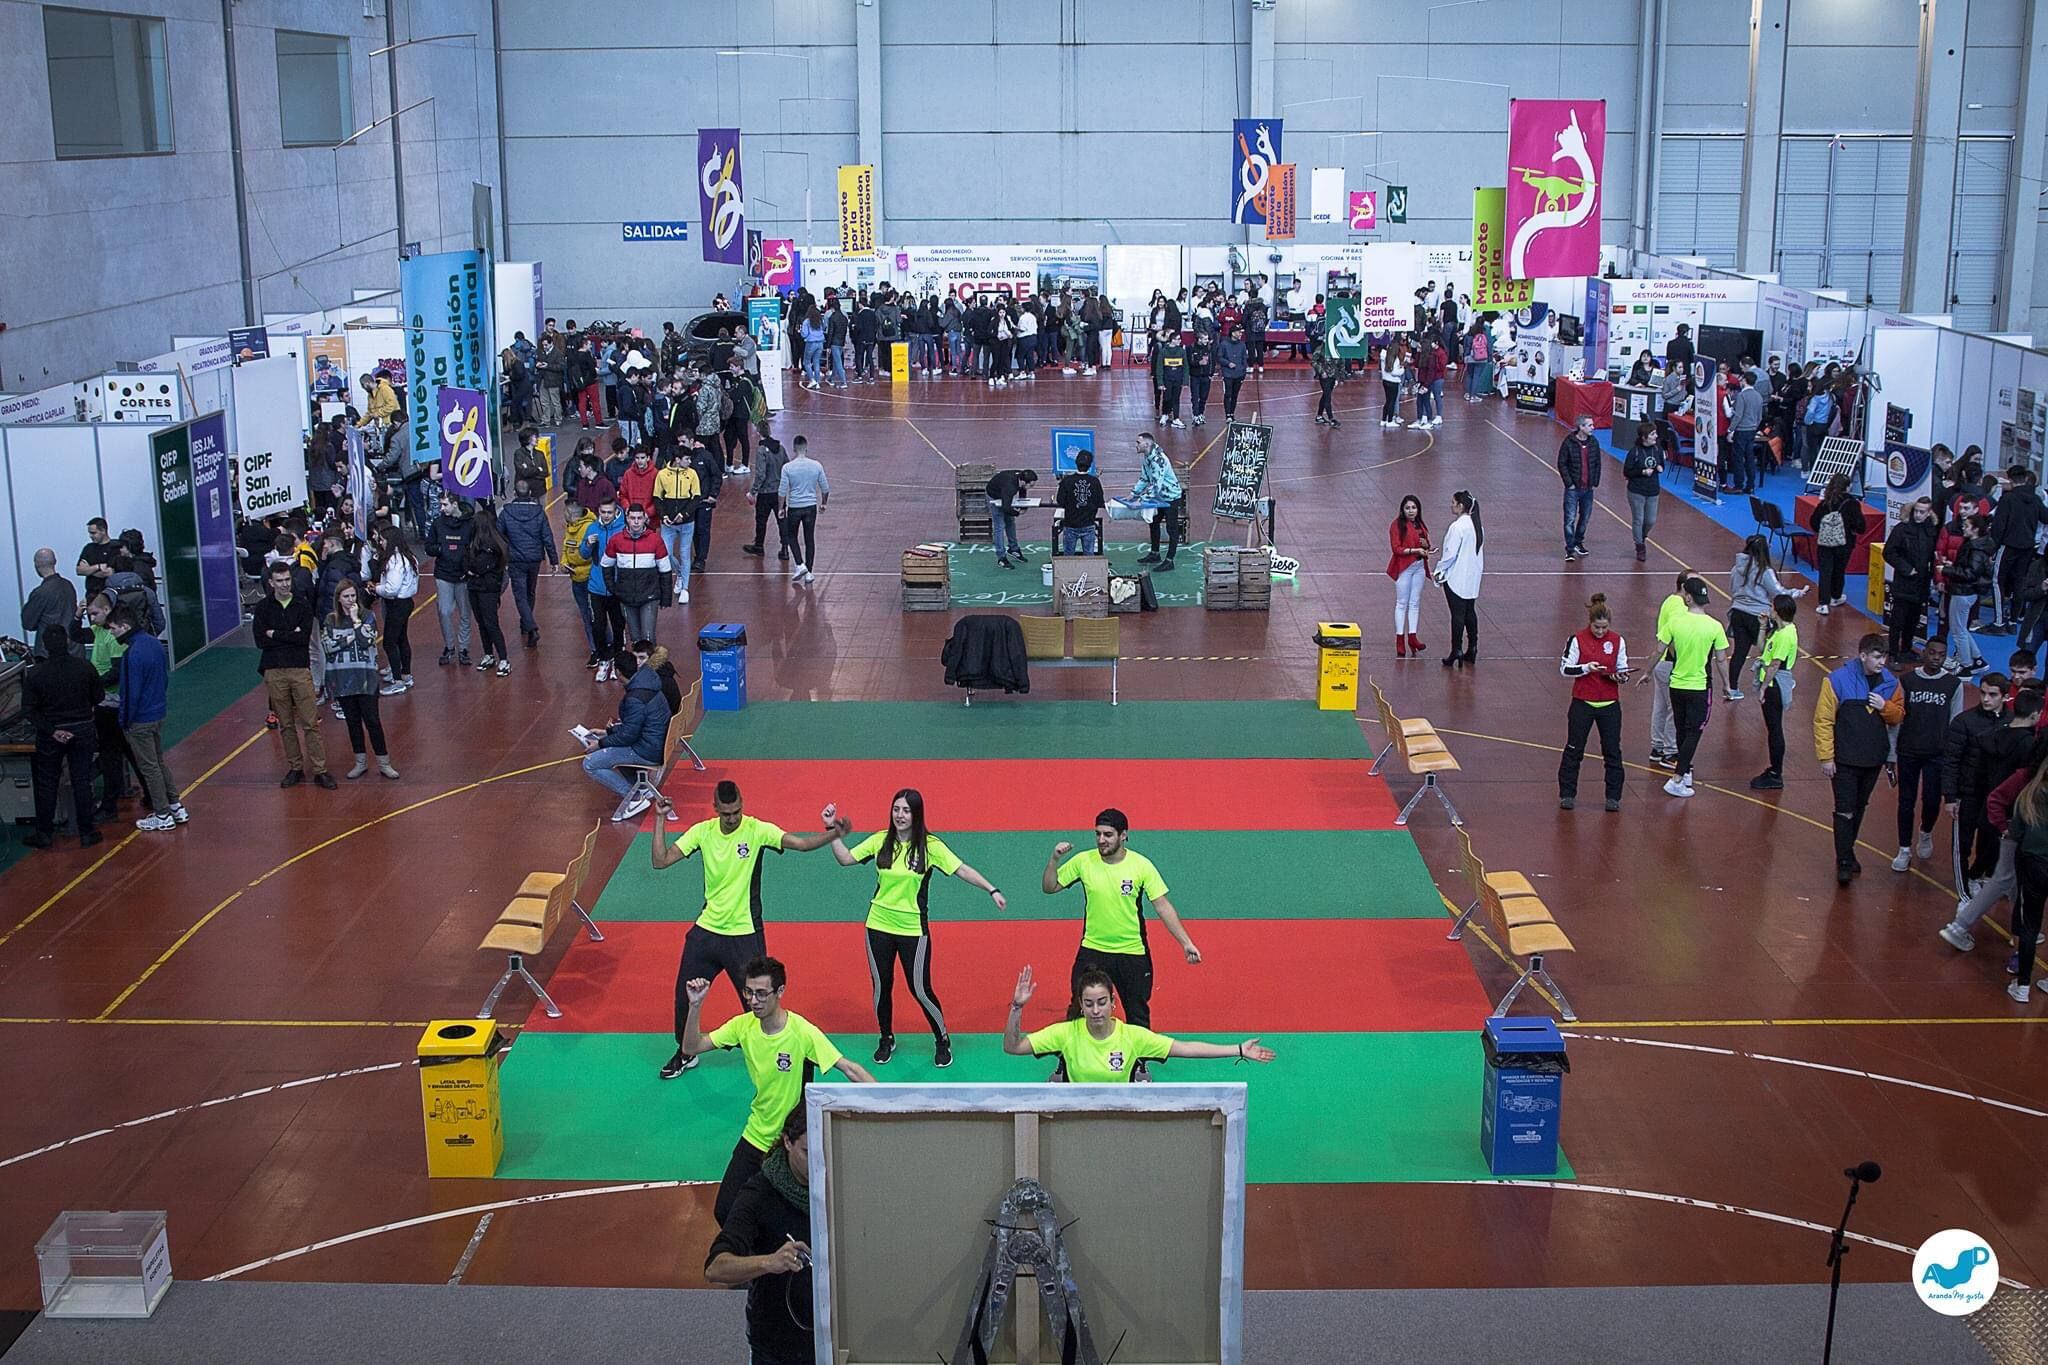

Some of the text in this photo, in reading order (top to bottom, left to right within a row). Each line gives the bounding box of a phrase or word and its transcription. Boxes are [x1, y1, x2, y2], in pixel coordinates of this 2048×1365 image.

[864, 170, 872, 250] Profesional
[1276, 202, 1282, 213] la
[850, 211, 857, 224] la
[624, 225, 674, 238] SALIDA
[1476, 223, 1488, 304] Muévete
[948, 270, 1031, 280] CENTRO CONCERTADO
[1490, 249, 1501, 304] por la
[1364, 296, 1388, 306] CIPF
[1631, 291, 1664, 299] GESTIÓN
[1364, 307, 1395, 317] Santa
[1364, 316, 1407, 328] Catalina
[199, 346, 214, 357] GRADO
[411, 313, 430, 451] Muévete
[1, 397, 41, 415] GRADO MEDIO:
[120, 398, 172, 408] CORTES
[44, 406, 65, 420] CAPILAR
[192, 440, 204, 455] IES
[160, 450, 178, 469] CIFP
[244, 452, 273, 473] CIPF
[161, 472, 177, 487] San
[246, 475, 270, 492] San
[163, 480, 189, 503] Gabriel
[247, 486, 292, 511] Gabriel
